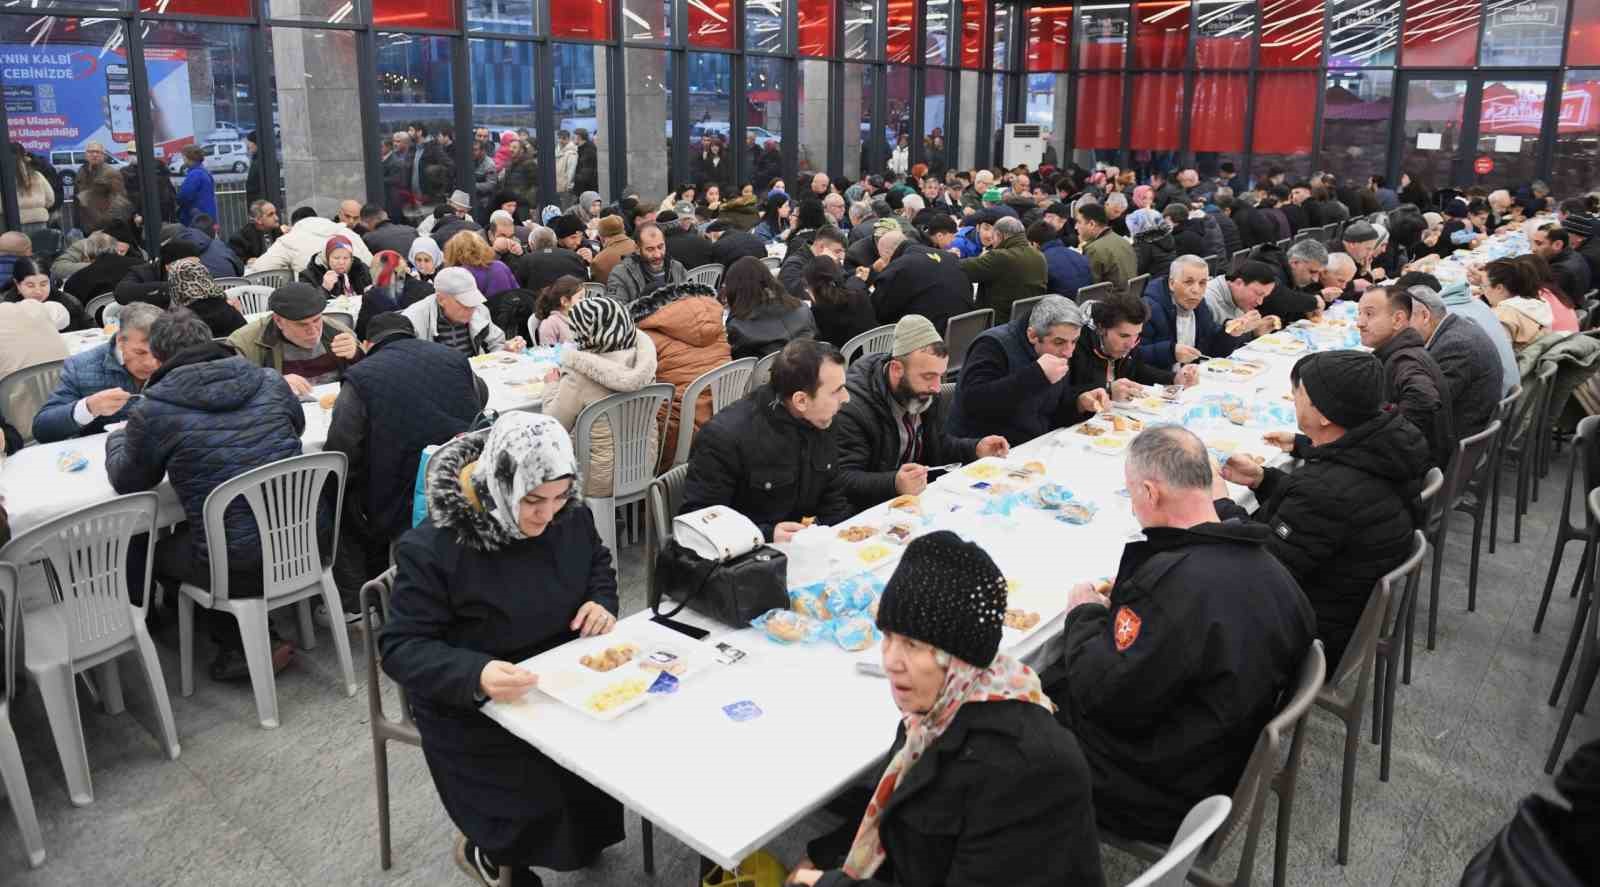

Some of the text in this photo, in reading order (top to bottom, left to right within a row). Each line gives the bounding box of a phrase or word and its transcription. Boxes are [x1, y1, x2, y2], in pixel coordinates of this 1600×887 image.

[0, 52, 72, 65] 'NIN KALBİ
[3, 66, 73, 80] CEBİNİZDE
